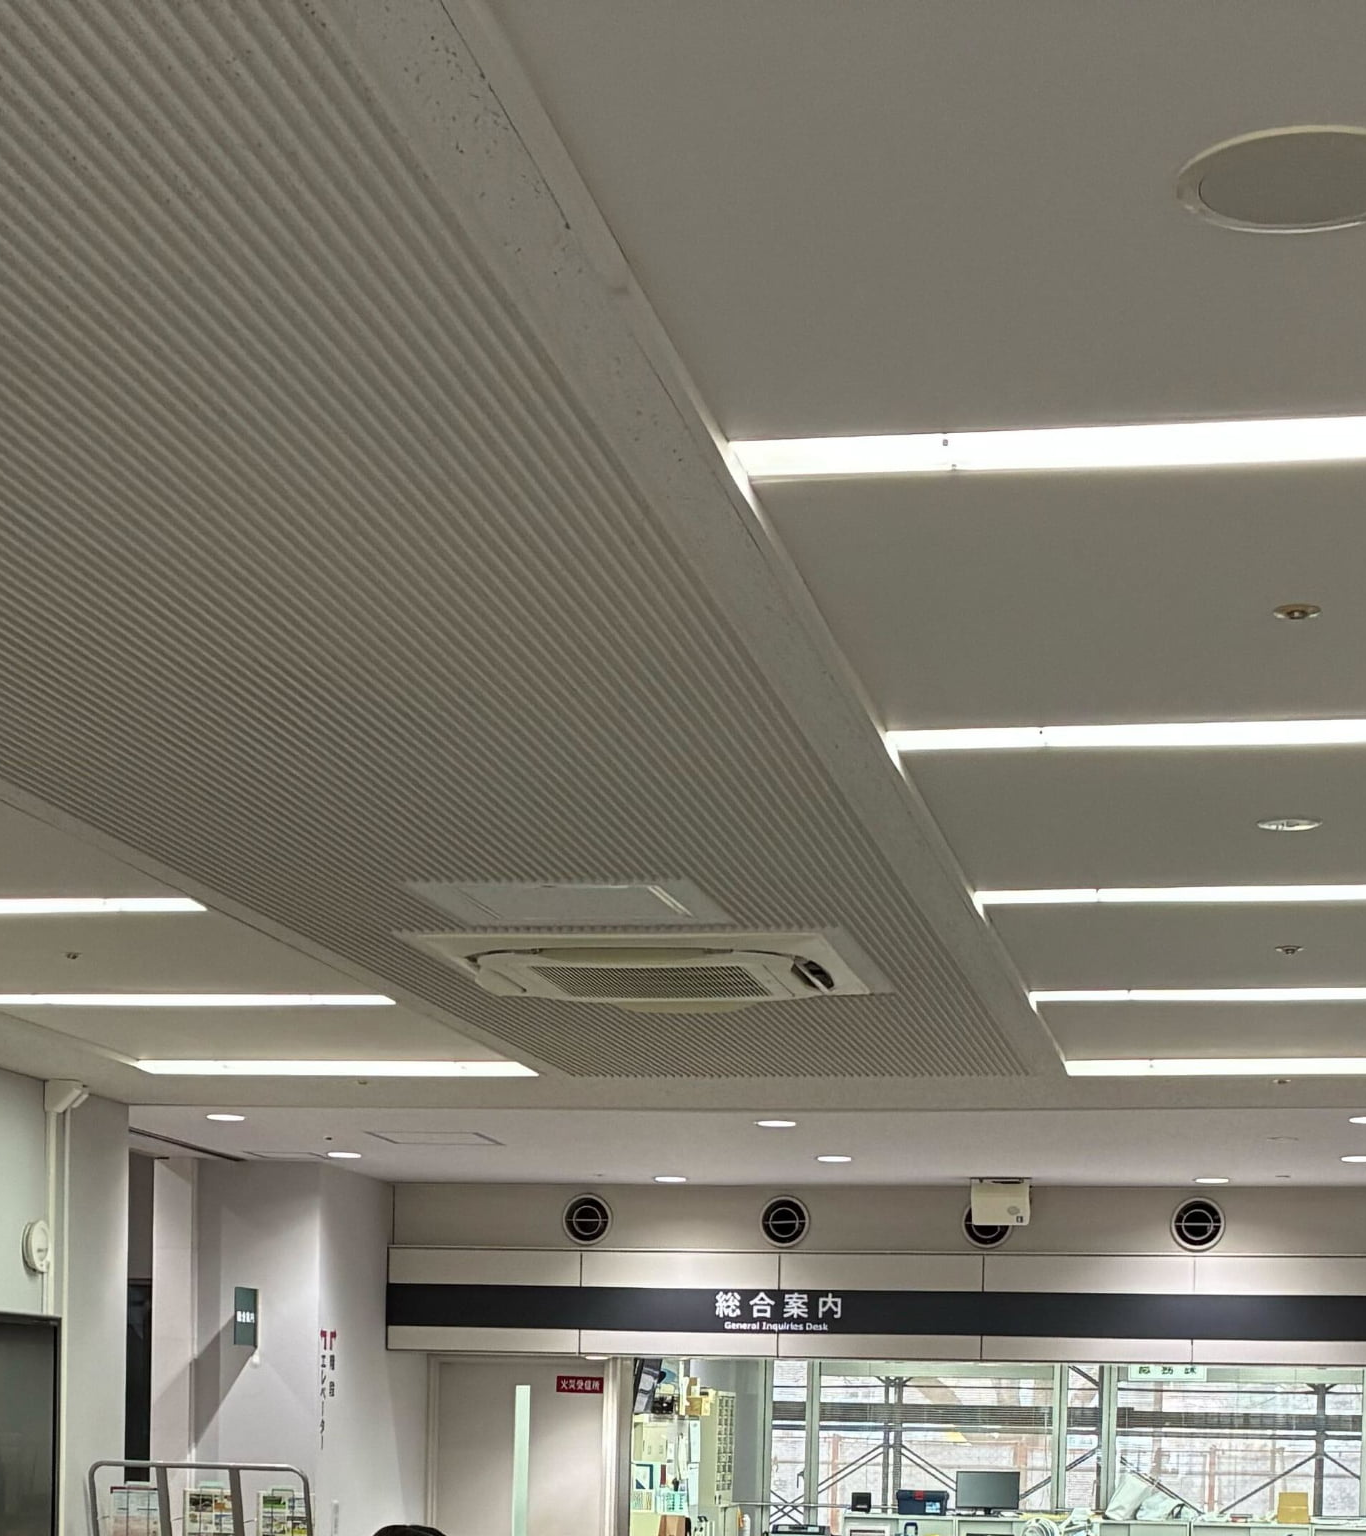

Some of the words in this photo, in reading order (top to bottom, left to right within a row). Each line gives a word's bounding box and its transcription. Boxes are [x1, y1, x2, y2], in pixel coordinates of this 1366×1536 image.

[715, 1291, 842, 1319] 総合案内
[724, 1321, 760, 1330] General
[762, 1321, 804, 1332] Inquiries
[806, 1322, 829, 1331] Desk
